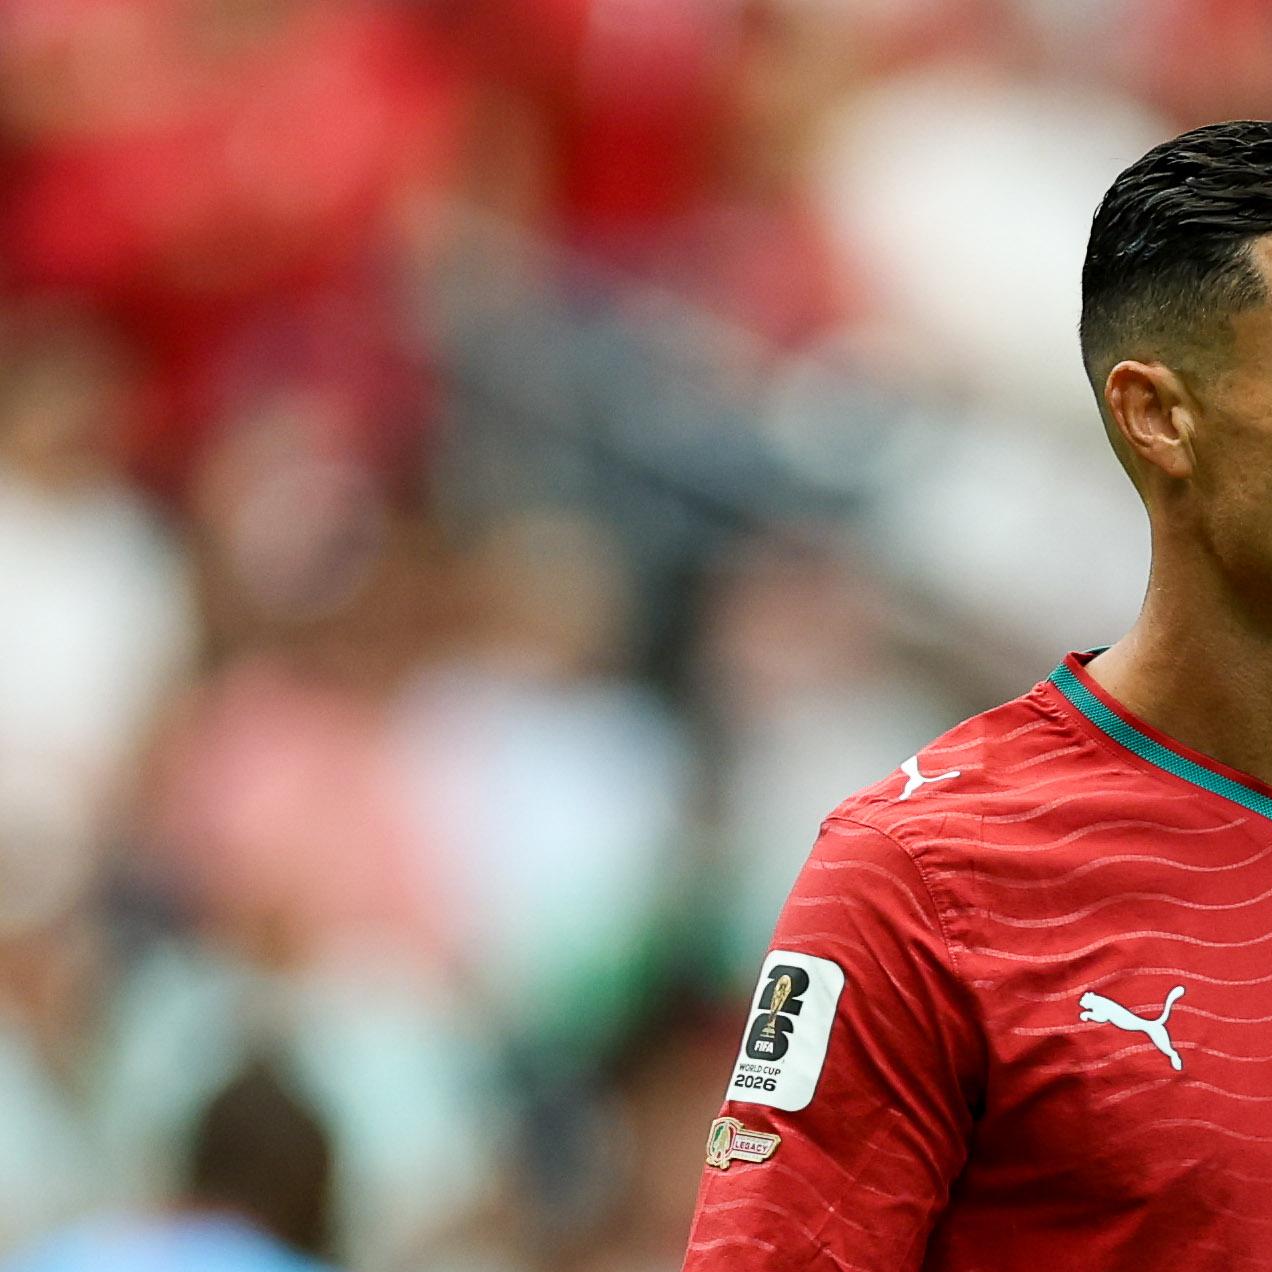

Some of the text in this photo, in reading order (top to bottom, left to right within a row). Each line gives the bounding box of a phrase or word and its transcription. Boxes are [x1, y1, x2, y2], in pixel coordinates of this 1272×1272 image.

[754, 1040, 774, 1055] FIFA
[739, 1063, 781, 1076] WORLD CUP
[735, 1074, 777, 1091] 2026
[735, 1141, 768, 1152] LEGACY
